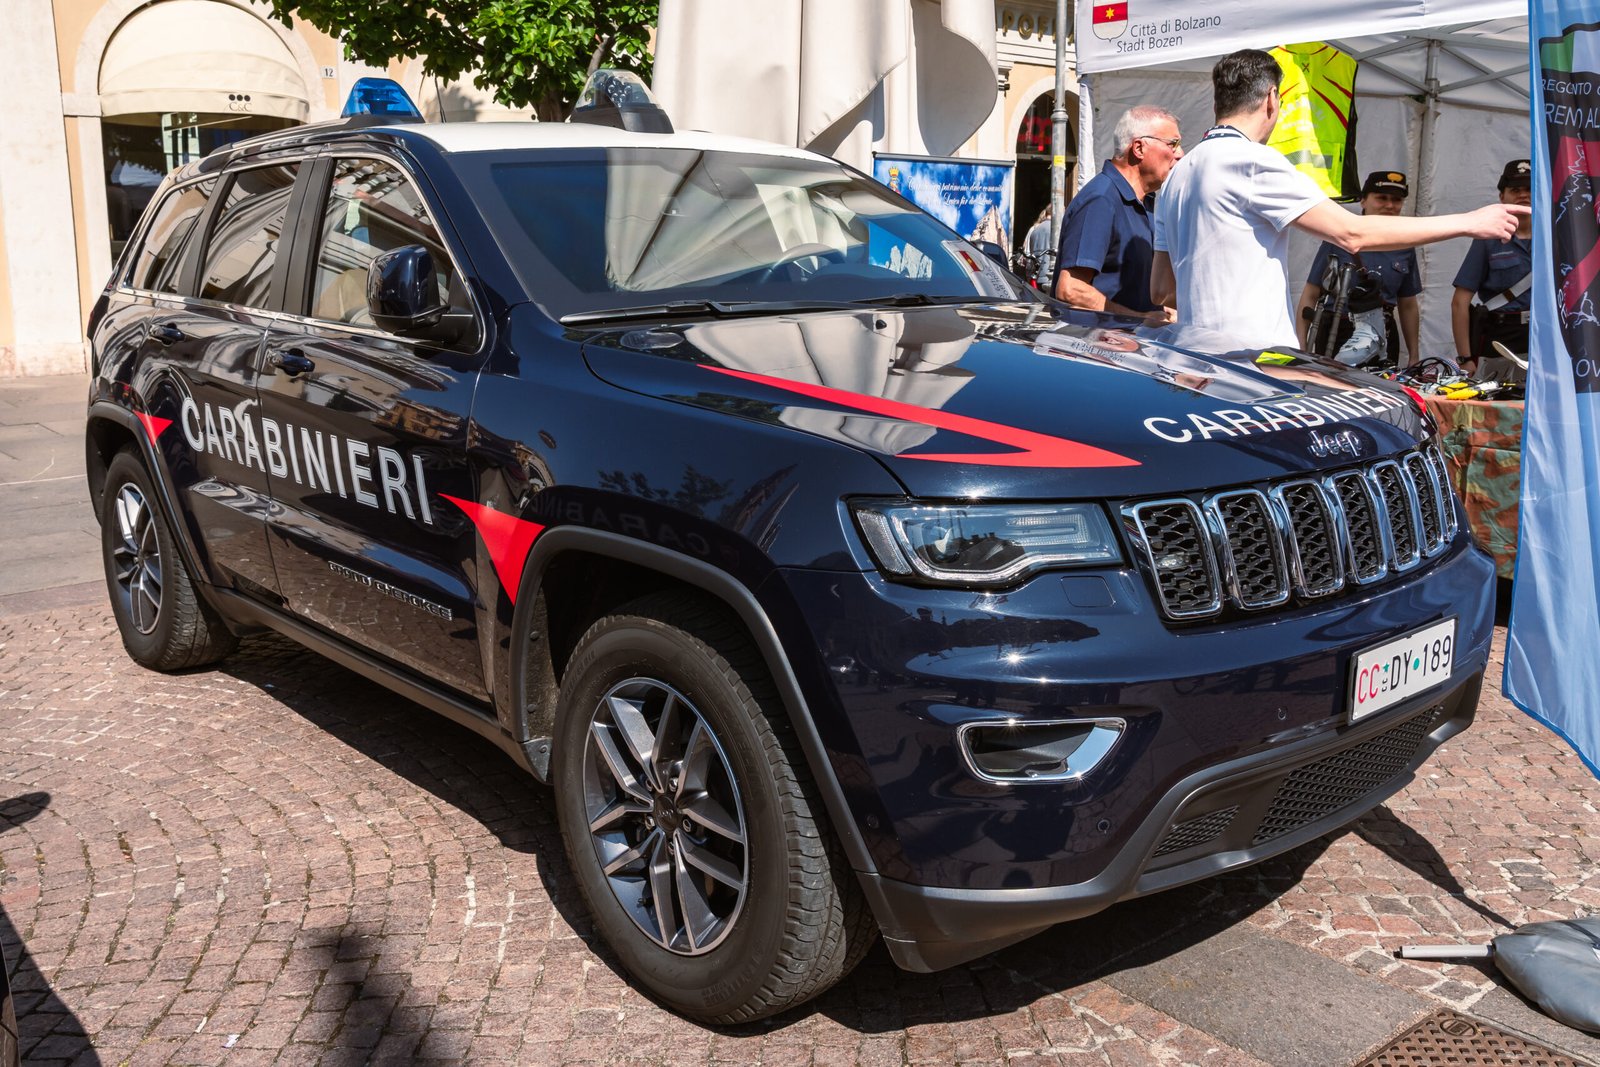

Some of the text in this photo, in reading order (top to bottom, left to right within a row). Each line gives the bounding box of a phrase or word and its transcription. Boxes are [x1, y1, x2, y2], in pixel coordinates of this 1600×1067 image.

[1130, 15, 1222, 38] Città di Bolzano
[1116, 35, 1183, 53] Stadt Bozen
[324, 67, 334, 78] 12
[1143, 386, 1407, 443] CARABINIERI
[1307, 430, 1363, 458] Jeep
[181, 397, 433, 525] CARABINIERI
[1358, 635, 1452, 704] CC DY 189
